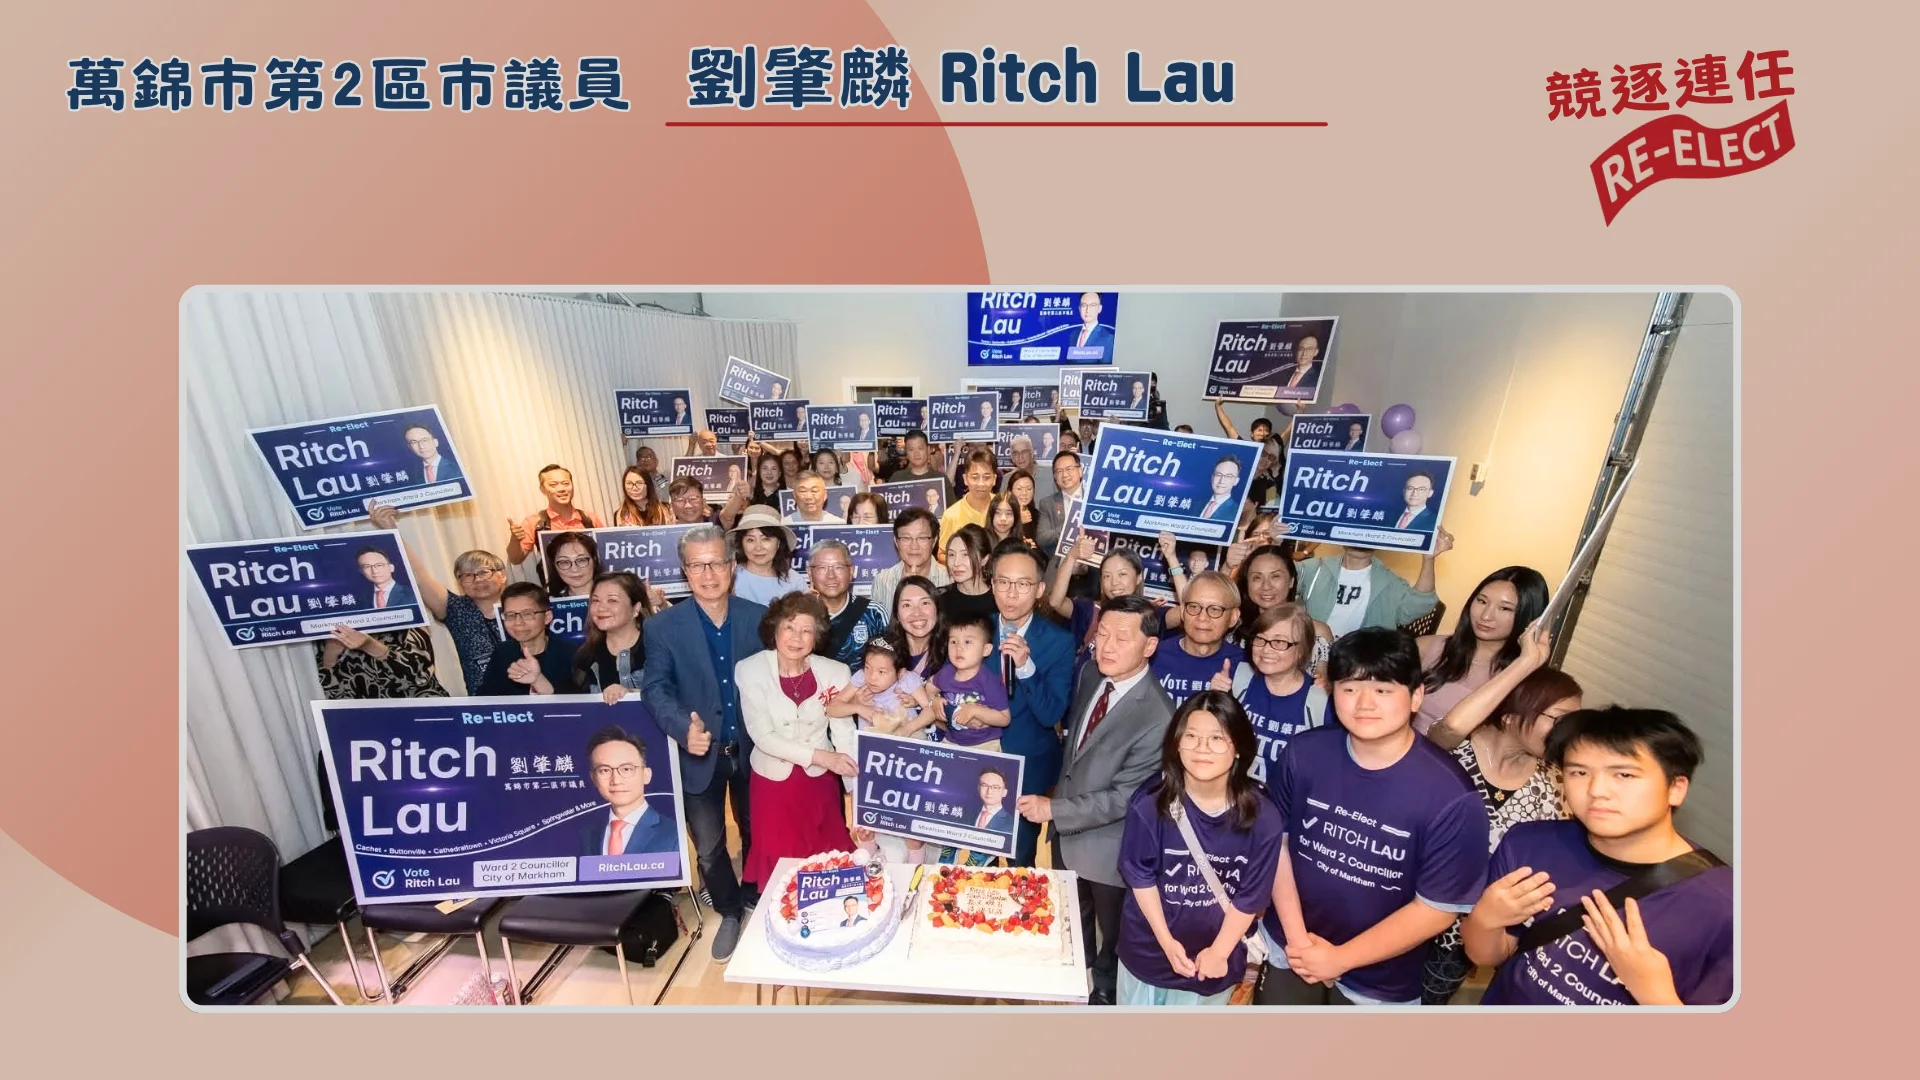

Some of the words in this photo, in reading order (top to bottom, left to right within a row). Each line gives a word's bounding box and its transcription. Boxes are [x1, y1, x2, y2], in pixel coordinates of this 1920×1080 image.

[980, 314, 1022, 335] Lau
[1218, 333, 1268, 351] Ritch
[1213, 356, 1250, 373] Lau
[729, 364, 761, 385] Ritch
[726, 377, 750, 394] Lau
[1084, 379, 1118, 392] Ritch
[621, 397, 658, 410] Ritch
[1083, 394, 1108, 406] Lau
[752, 406, 784, 418] Ritch
[877, 404, 908, 416] Ritch
[932, 402, 966, 415] Ritch
[623, 412, 650, 425] Lau
[709, 413, 736, 424] Ritch
[811, 413, 844, 426] Ritch
[877, 417, 900, 428] Lau
[932, 418, 957, 430] Lau
[329, 421, 369, 433] Re-Elect
[754, 420, 777, 431] Lau
[1296, 422, 1334, 435] Ritch
[812, 428, 837, 440] Lau
[1162, 438, 1196, 450] Re-Elect
[1294, 436, 1322, 448] Lau
[274, 435, 370, 471] Ritch
[1102, 444, 1181, 478] Ritch
[1348, 459, 1384, 467] Re-Elect
[676, 464, 713, 477] Ritch
[1293, 466, 1369, 493] Ritch
[293, 473, 362, 500] Lau
[1095, 477, 1153, 506] Lau
[1289, 494, 1344, 519] Lau
[274, 543, 319, 553] Re-Elect
[605, 539, 661, 560] Ritch
[209, 557, 316, 589] Ritch
[224, 595, 301, 620] Lau
[462, 710, 534, 725] Re-Elect
[350, 736, 496, 782] Ritch
[919, 748, 954, 759] Re-Elect
[865, 750, 943, 785] Ritch
[864, 781, 921, 812] Lau
[363, 796, 467, 836] Lau
[1334, 805, 1378, 828] Re-Elect
[356, 844, 381, 853] Cachet
[389, 847, 426, 855] Buttonville
[488, 834, 514, 845] Victoria
[580, 801, 596, 809] More
[1323, 821, 1369, 850] RITCH
[1371, 840, 1406, 861] LAU
[1299, 834, 1311, 847] for
[1312, 840, 1337, 859] Ward
[1338, 852, 1347, 863] 2
[1348, 856, 1404, 879] Councillor
[402, 868, 430, 877] Vote
[480, 863, 508, 872] Ward
[520, 860, 570, 870] Councillor
[599, 860, 665, 873] RitchLau.ca
[482, 873, 502, 883] City
[505, 872, 516, 881] of
[518, 870, 565, 881] Markham
[1316, 860, 1330, 873] City
[1330, 867, 1339, 876] of
[1339, 870, 1376, 888] Markham
[405, 877, 435, 888] Ritch
[438, 877, 460, 886] Lau
[801, 874, 840, 889] Ritch
[1164, 883, 1179, 893] for
[1199, 884, 1206, 894] 2
[800, 889, 829, 902] Lau
[1550, 963, 1563, 977] 2
[1537, 978, 1549, 989] of
